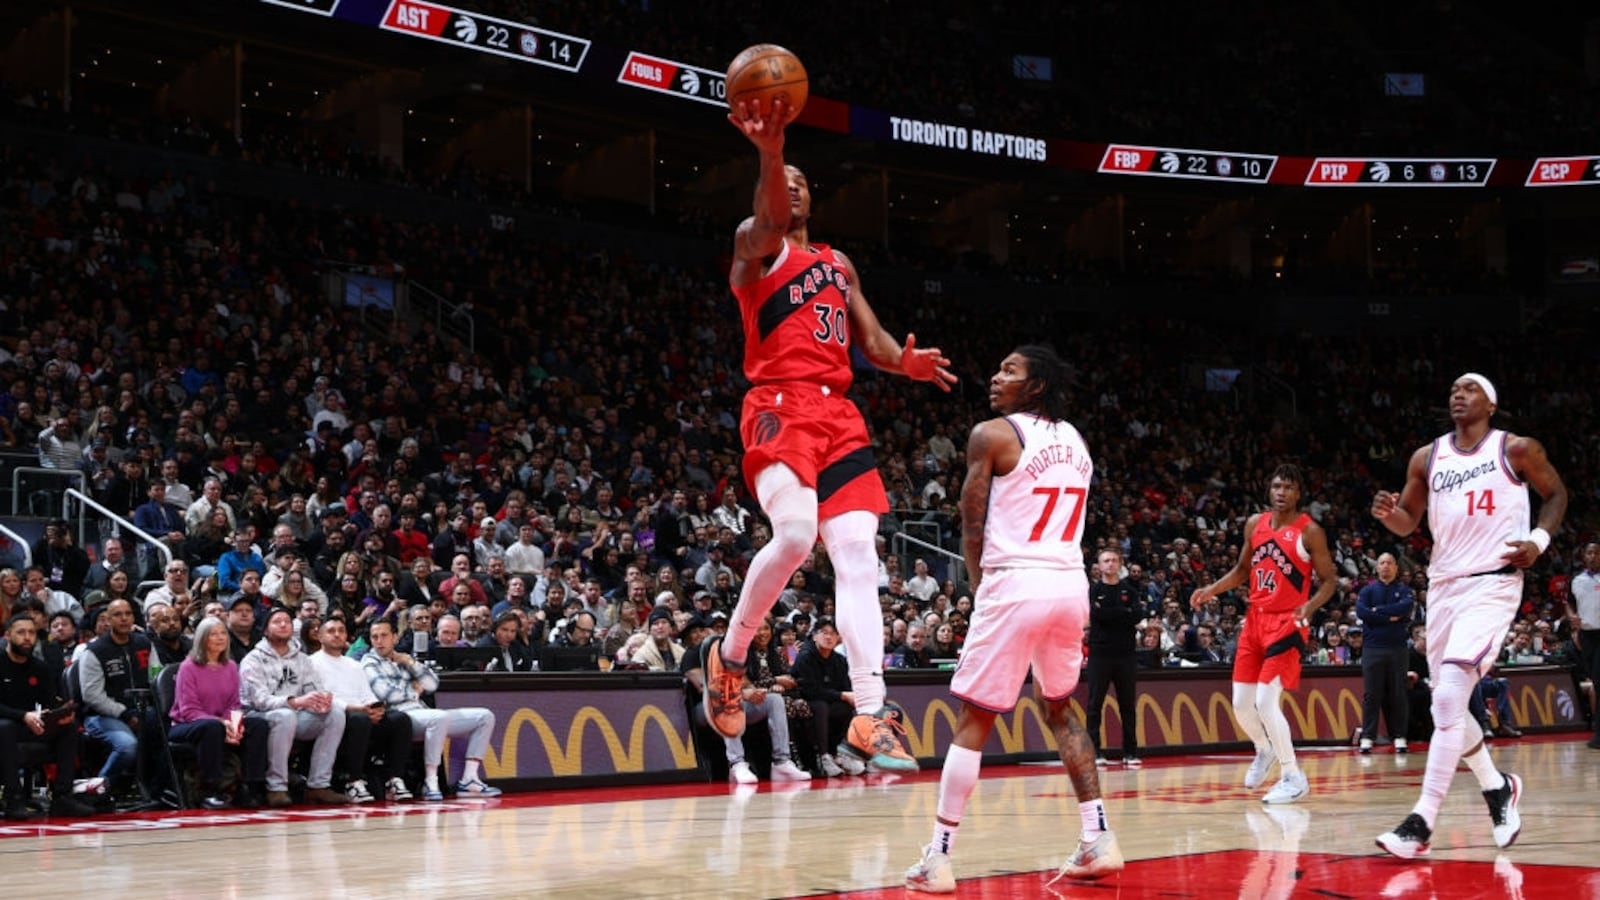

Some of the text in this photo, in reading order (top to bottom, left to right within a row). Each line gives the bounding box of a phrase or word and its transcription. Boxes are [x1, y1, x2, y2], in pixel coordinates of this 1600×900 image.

[396, 4, 571, 62] AST 22 14
[630, 62, 726, 99] FOULS 10
[890, 116, 1047, 162] TORONTO RAPTORS
[1114, 151, 1261, 176] FBP 22 10
[1321, 163, 1478, 181] PIP 6 13
[1540, 163, 1570, 180] 2CP
[813, 302, 847, 346] 30
[1025, 444, 1074, 481] PORTER
[1432, 459, 1497, 493] Clippers
[1027, 487, 1087, 542] 77
[1464, 489, 1496, 516] 14
[1251, 543, 1293, 575] APTORS
[1255, 568, 1277, 593] 14
